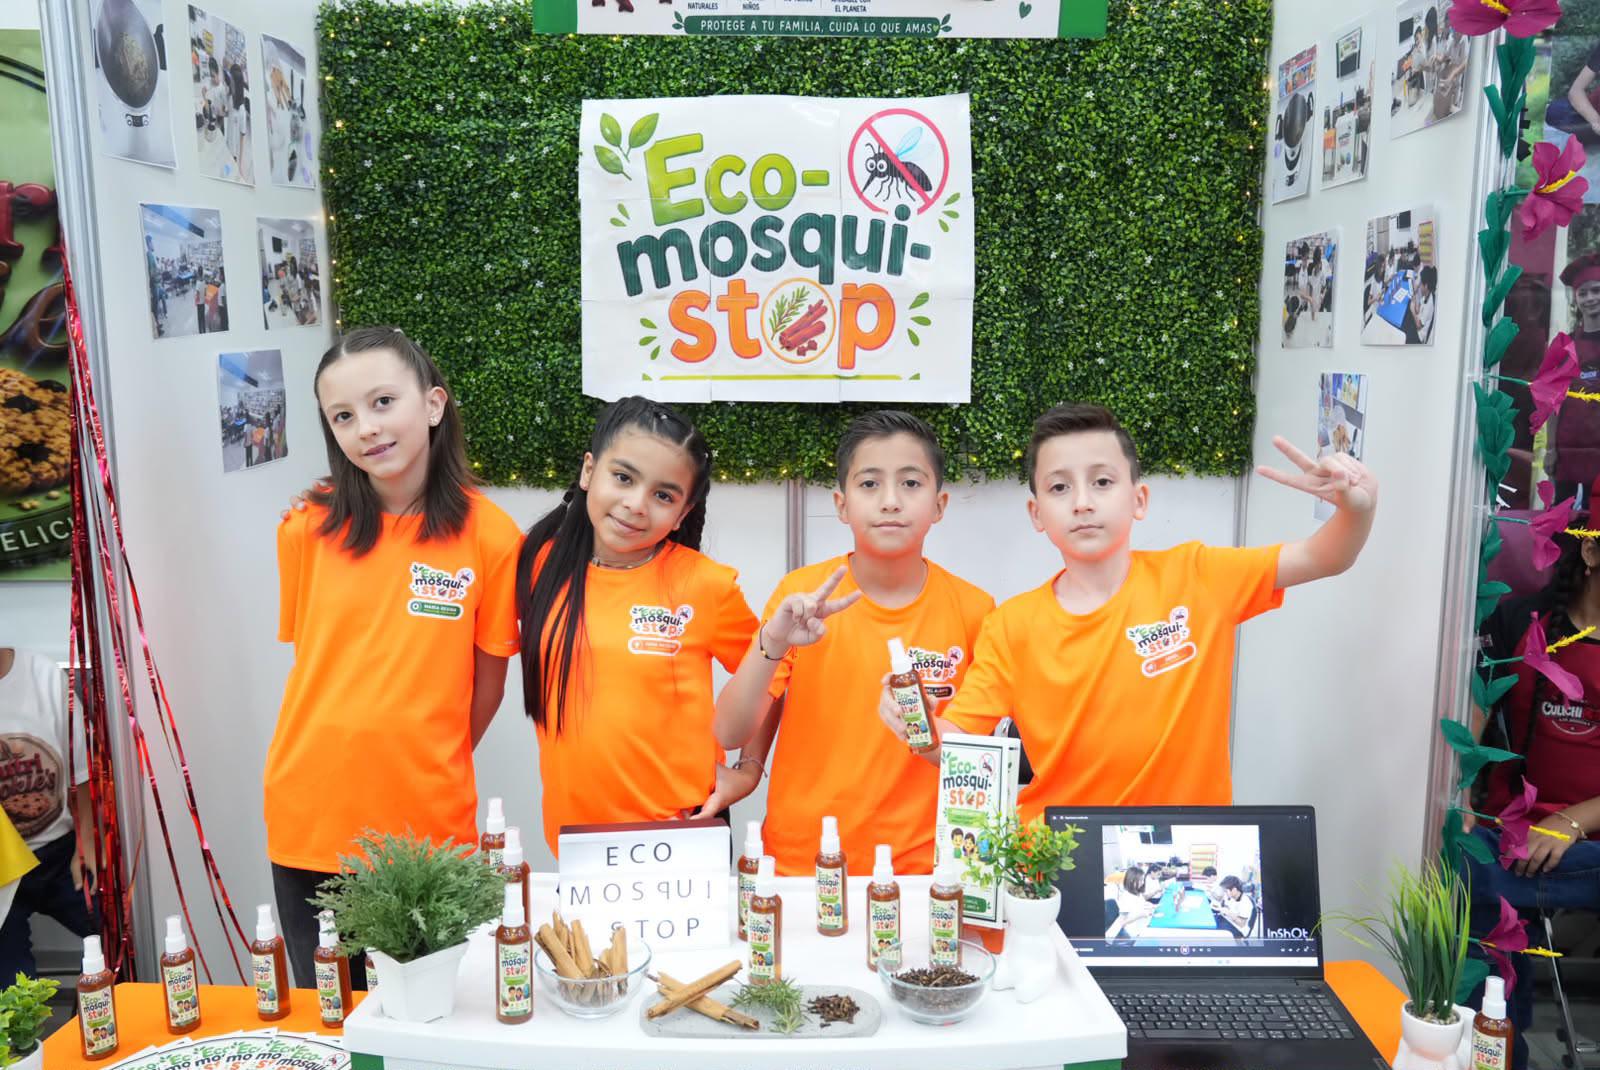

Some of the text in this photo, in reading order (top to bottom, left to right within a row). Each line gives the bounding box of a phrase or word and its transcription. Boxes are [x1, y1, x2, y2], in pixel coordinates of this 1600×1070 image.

[687, 2, 719, 10] NATURALES
[834, 5, 867, 13] EL PLANETA
[700, 20, 932, 34] PROTEGE A TU FAMILIA, CUIDA LO QUE AMAS
[644, 132, 830, 227] Eco-
[616, 203, 932, 297] mosqui-
[606, 842, 672, 866] ECO
